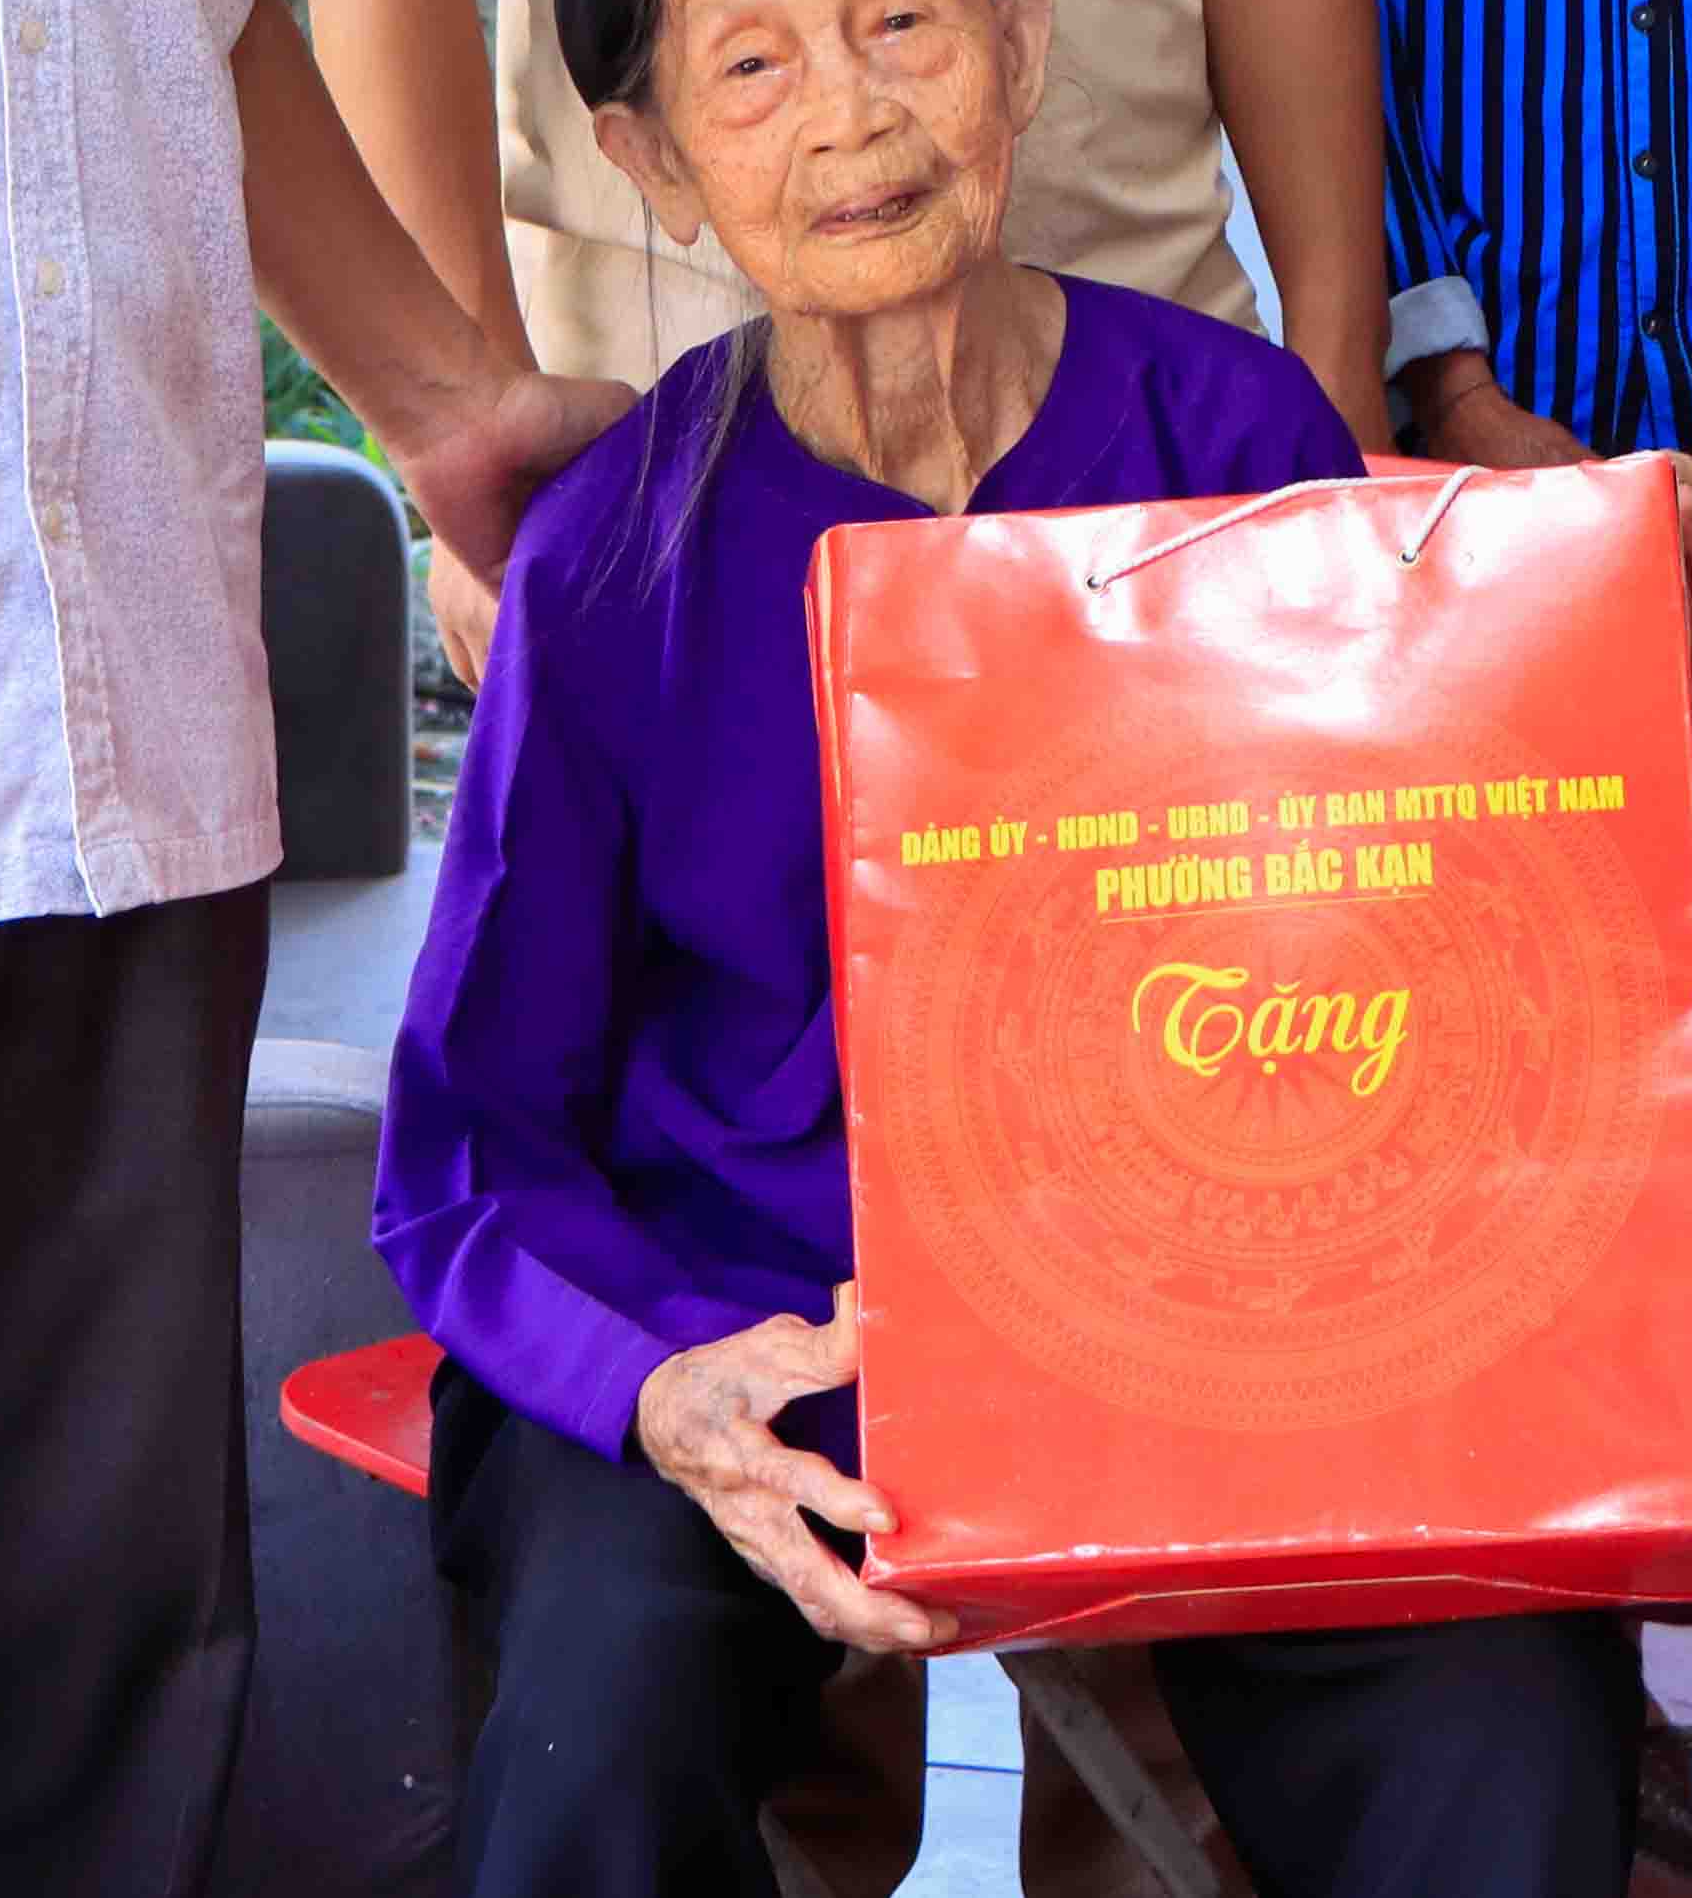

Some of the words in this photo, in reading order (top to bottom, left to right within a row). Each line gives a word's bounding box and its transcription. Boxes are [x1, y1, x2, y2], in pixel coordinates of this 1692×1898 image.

[900, 821, 981, 867] ĐẢNG
[990, 815, 1027, 858] ỦY
[1036, 834, 1048, 844] -
[1057, 810, 1139, 851] HĐND
[1148, 824, 1158, 833] -
[1167, 800, 1250, 840] UBND
[1277, 789, 1317, 830] ỦY
[1325, 789, 1386, 827] BAN
[1395, 783, 1477, 822] MTTQ
[1484, 774, 1549, 820] VIỆT
[1557, 774, 1624, 813] NAM
[1096, 853, 1253, 914] PHƯỜNG
[1264, 839, 1344, 897] BẮC
[1355, 842, 1435, 895] KẠN
[1132, 962, 1411, 1096] Tặng
